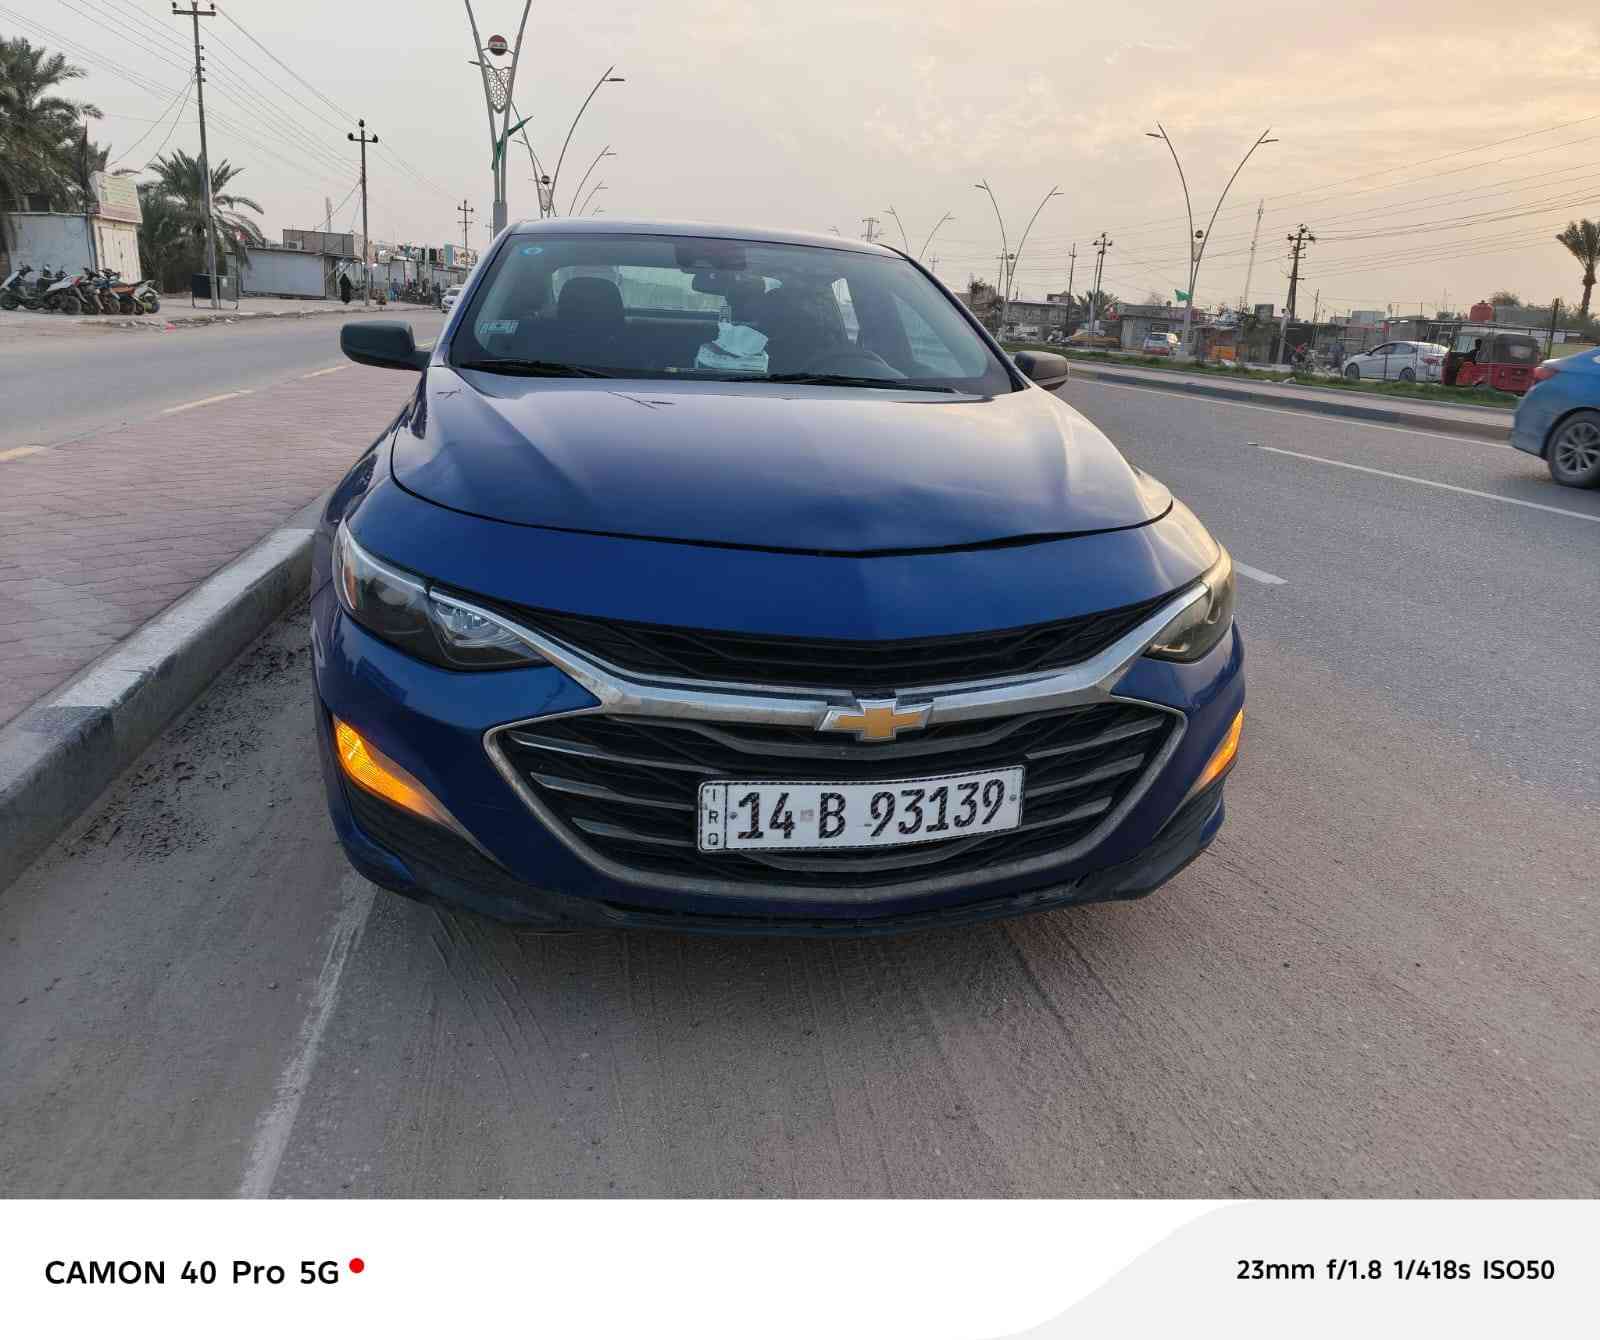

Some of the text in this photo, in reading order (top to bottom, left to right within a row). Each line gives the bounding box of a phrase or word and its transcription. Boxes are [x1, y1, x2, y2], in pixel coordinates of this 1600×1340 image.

[737, 778, 1005, 840] 14 B 93139
